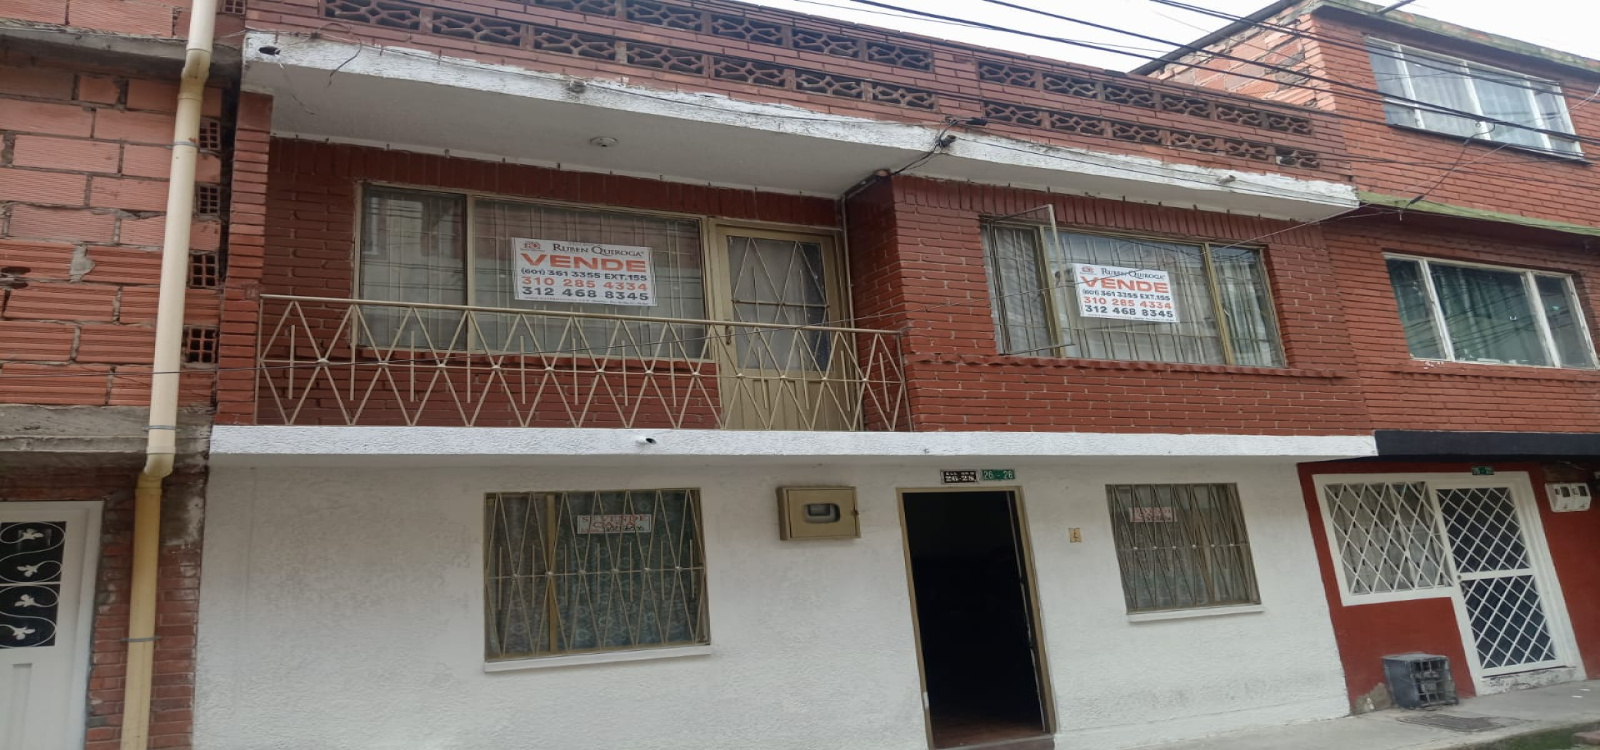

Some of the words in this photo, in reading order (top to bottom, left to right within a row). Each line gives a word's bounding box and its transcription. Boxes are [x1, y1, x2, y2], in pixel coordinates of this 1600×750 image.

[521, 253, 647, 273] VENDE
[521, 267, 545, 276] (601)
[549, 269, 568, 277] 361
[571, 271, 600, 279] 3355
[522, 276, 555, 286] 310
[563, 279, 596, 288] 285
[603, 281, 648, 291] 4334
[1080, 276, 1169, 293] VENDE
[522, 286, 554, 296] 312
[562, 288, 596, 298] 468
[605, 290, 649, 301] 8345
[1084, 296, 1106, 304] 310
[1112, 298, 1135, 306] 285
[1140, 300, 1172, 309] 4334
[1085, 305, 1108, 313] 312
[1112, 307, 1136, 315] 468
[1142, 309, 1173, 318] 8345
